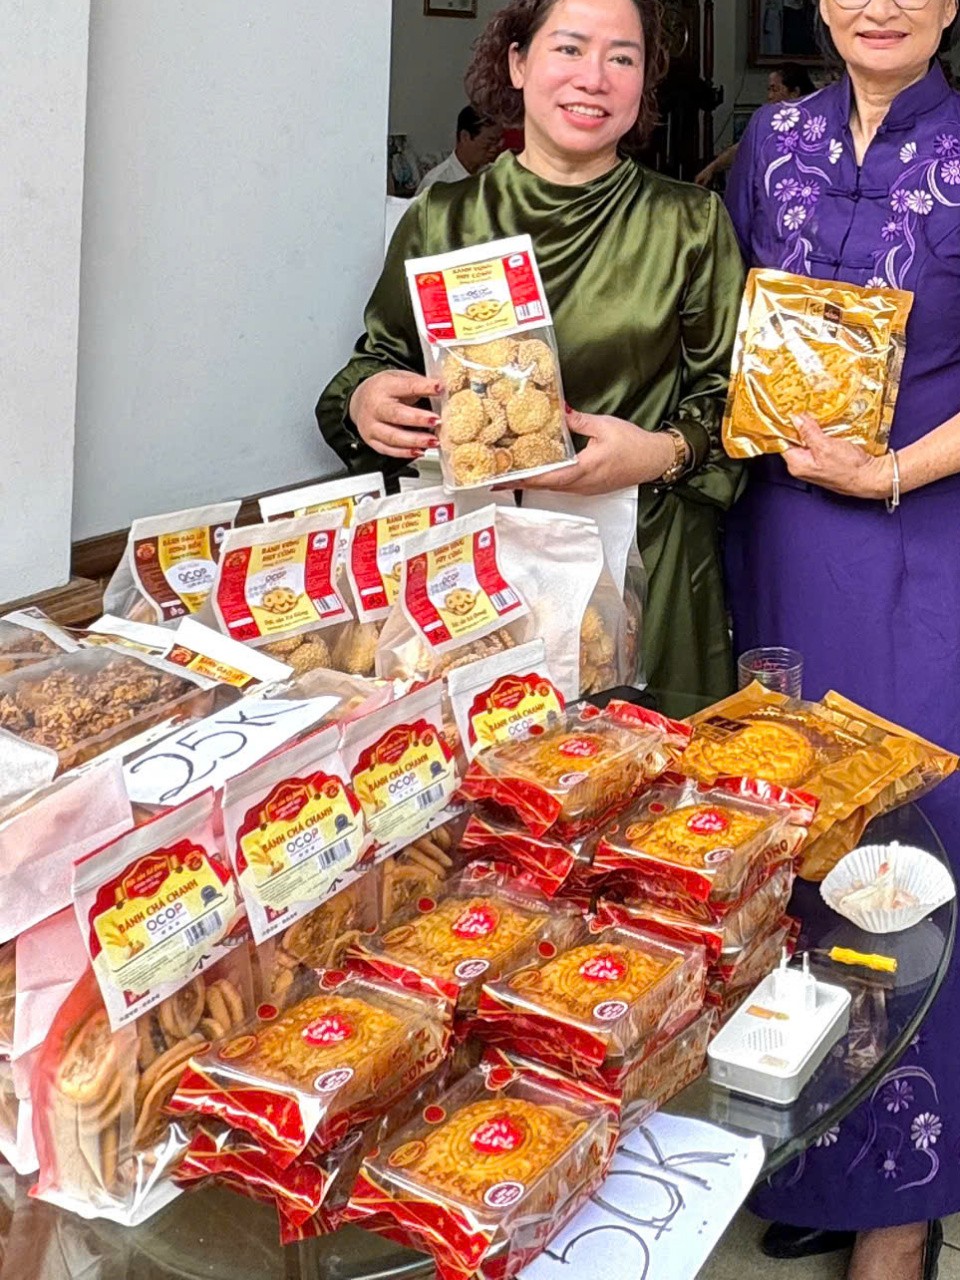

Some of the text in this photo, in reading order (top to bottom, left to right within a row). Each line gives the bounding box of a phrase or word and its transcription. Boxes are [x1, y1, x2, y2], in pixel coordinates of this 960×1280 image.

[387, 772, 417, 794] OCOP
[261, 834, 286, 853] BÁNH
[304, 806, 333, 829] CHANH
[286, 827, 320, 853] OCOP
[117, 912, 146, 935] BÁNH
[145, 898, 167, 919] CHẢ
[165, 878, 200, 904] CHANH
[146, 902, 184, 932] OCOP
